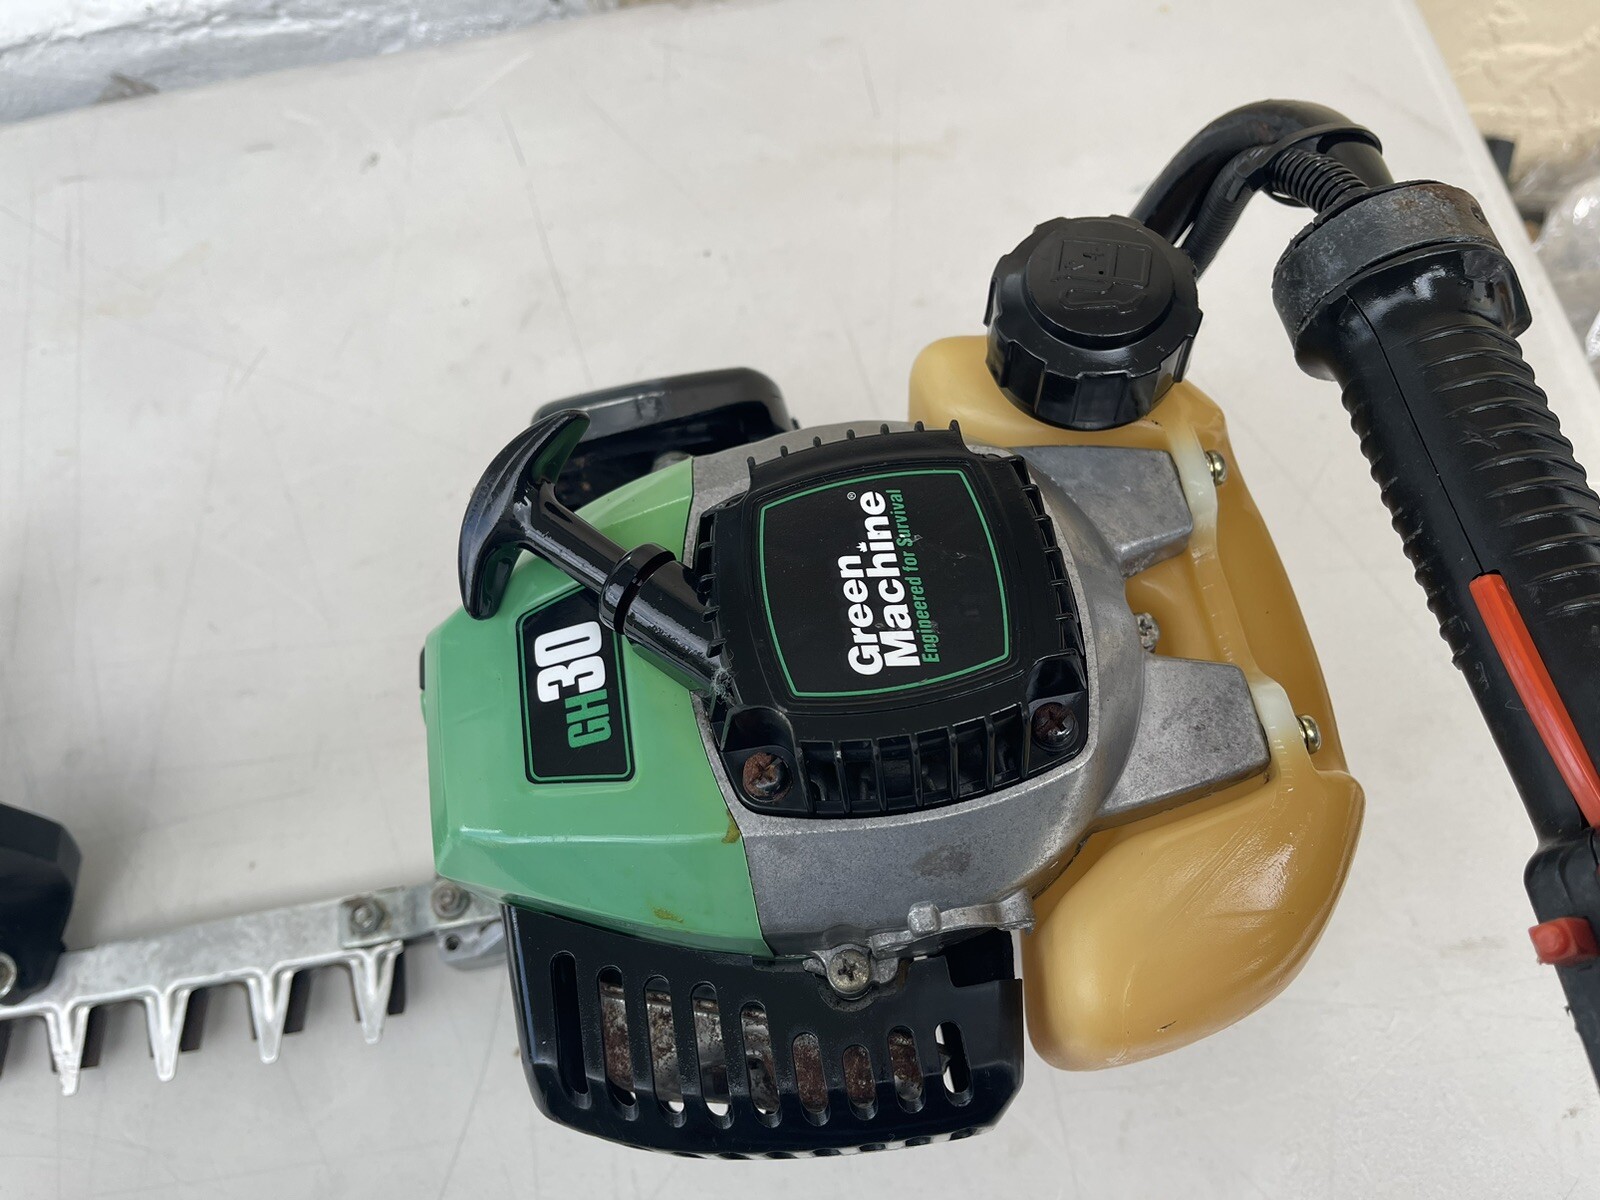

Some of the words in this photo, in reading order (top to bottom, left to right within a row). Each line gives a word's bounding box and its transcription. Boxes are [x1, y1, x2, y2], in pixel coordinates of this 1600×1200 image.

[885, 489, 913, 547] Survival
[902, 551, 919, 572] for
[837, 555, 883, 675] Green
[856, 491, 921, 667] Machine
[904, 576, 940, 663] Engineered
